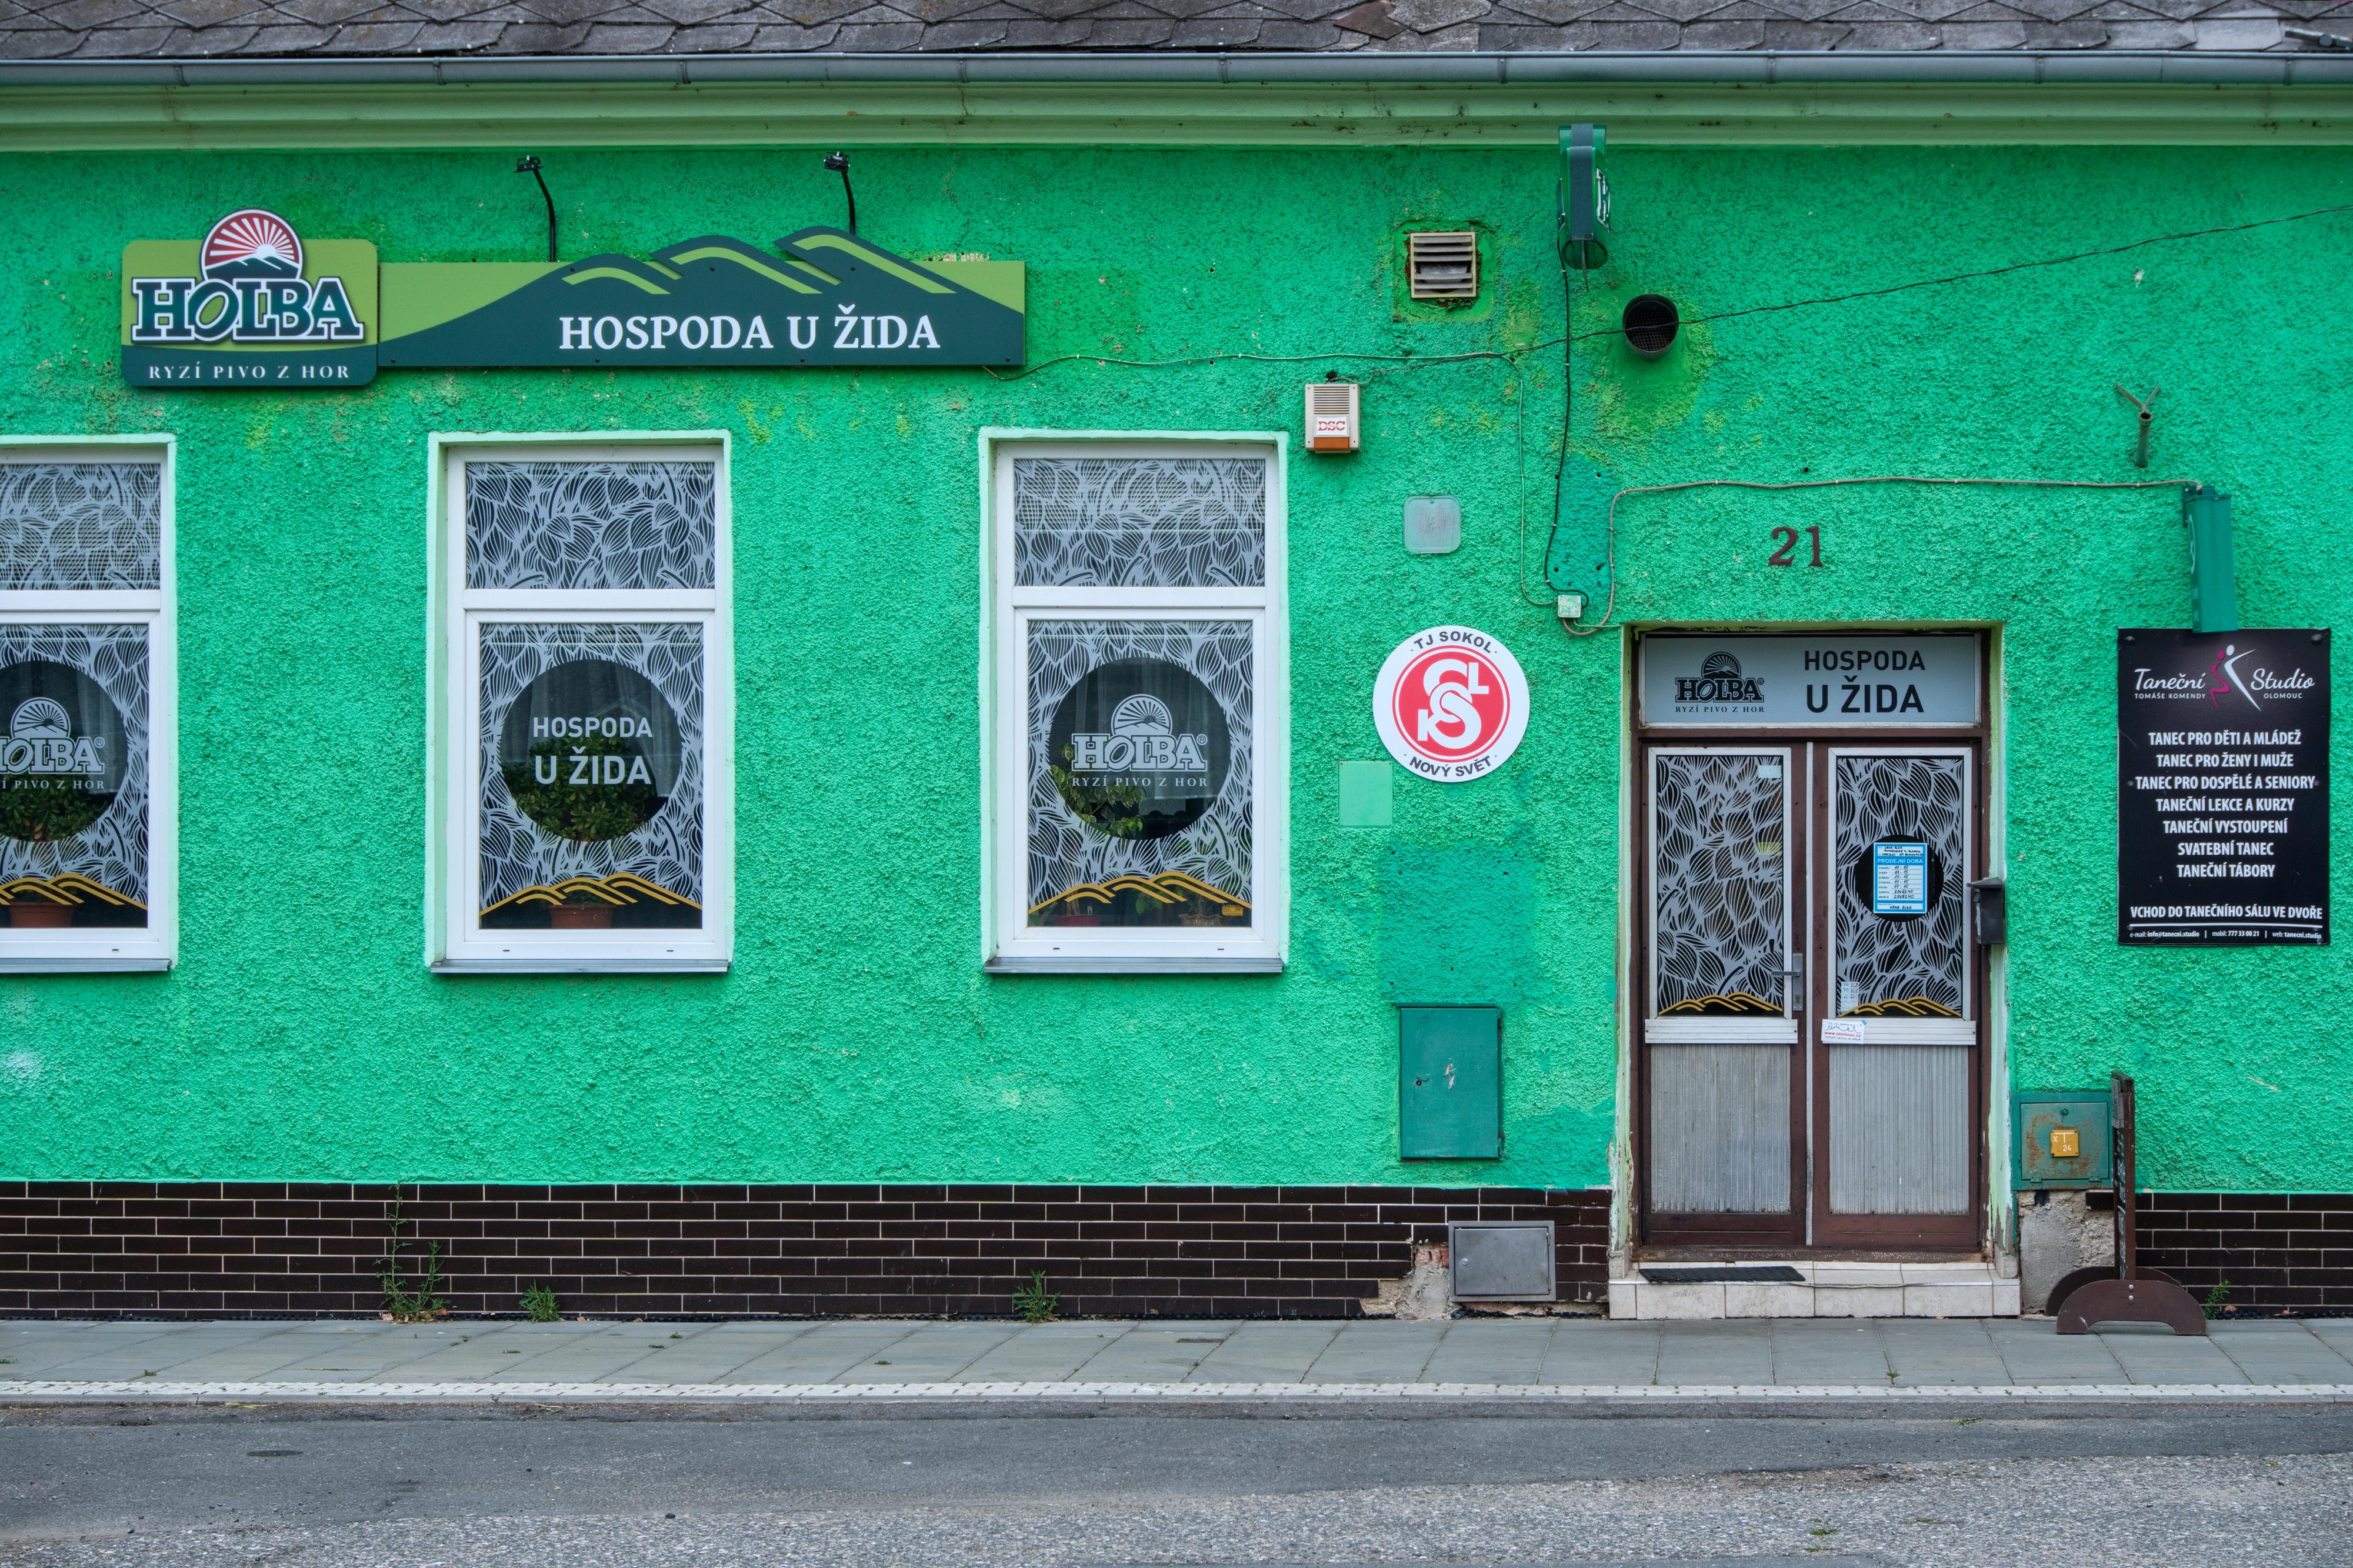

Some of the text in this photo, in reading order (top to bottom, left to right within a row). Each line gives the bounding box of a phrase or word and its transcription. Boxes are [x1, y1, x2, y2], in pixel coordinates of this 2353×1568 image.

[132, 276, 365, 342] HOLBA
[559, 303, 941, 349] HOSPODA U ŽIDA
[149, 361, 349, 379] RYZÍ PIVO Z HOR
[1318, 421, 1345, 431] DSC
[1768, 525, 1824, 567] 21
[1414, 630, 1492, 654] TJ SOKOL
[1805, 650, 1925, 670] HOSPODA
[2134, 668, 2315, 690] Taneční Studio
[1675, 678, 1764, 702] HOLBA
[1807, 675, 1924, 713] U ŽIDA
[533, 716, 653, 738] HOSPODA
[2148, 729, 2301, 745] TANEC PRO DĚTI A MLÁDEŽ
[0, 736, 105, 774] OLBA
[1071, 733, 1207, 772] HOLBA
[2157, 752, 2294, 767] TANEC PRO ŽENY I MUŽE
[535, 746, 652, 785] U ŽIDA
[1409, 755, 1492, 777] NOVÝ SVĚT
[15, 780, 49, 789] PIVO
[57, 780, 65, 789] Z
[73, 780, 105, 789] HOR
[1072, 775, 1207, 786] RYZÍ PIVO Z HOR
[2135, 773, 2315, 789] TANEC PRO DOSPĚLÉ A SENIORY
[2157, 796, 2294, 811] TANEČNÍ LEKCE A KURZY
[2164, 818, 2288, 833] TANEČNÍ VYSTOUPENÍ
[2178, 840, 2274, 855] SVATEBNÍ TANEC
[2177, 862, 2275, 877] TANEČNÍ TÁBORY
[2131, 904, 2322, 919] VCHOD DO TANEČNÍHO SÁLU VE DVOŘE
